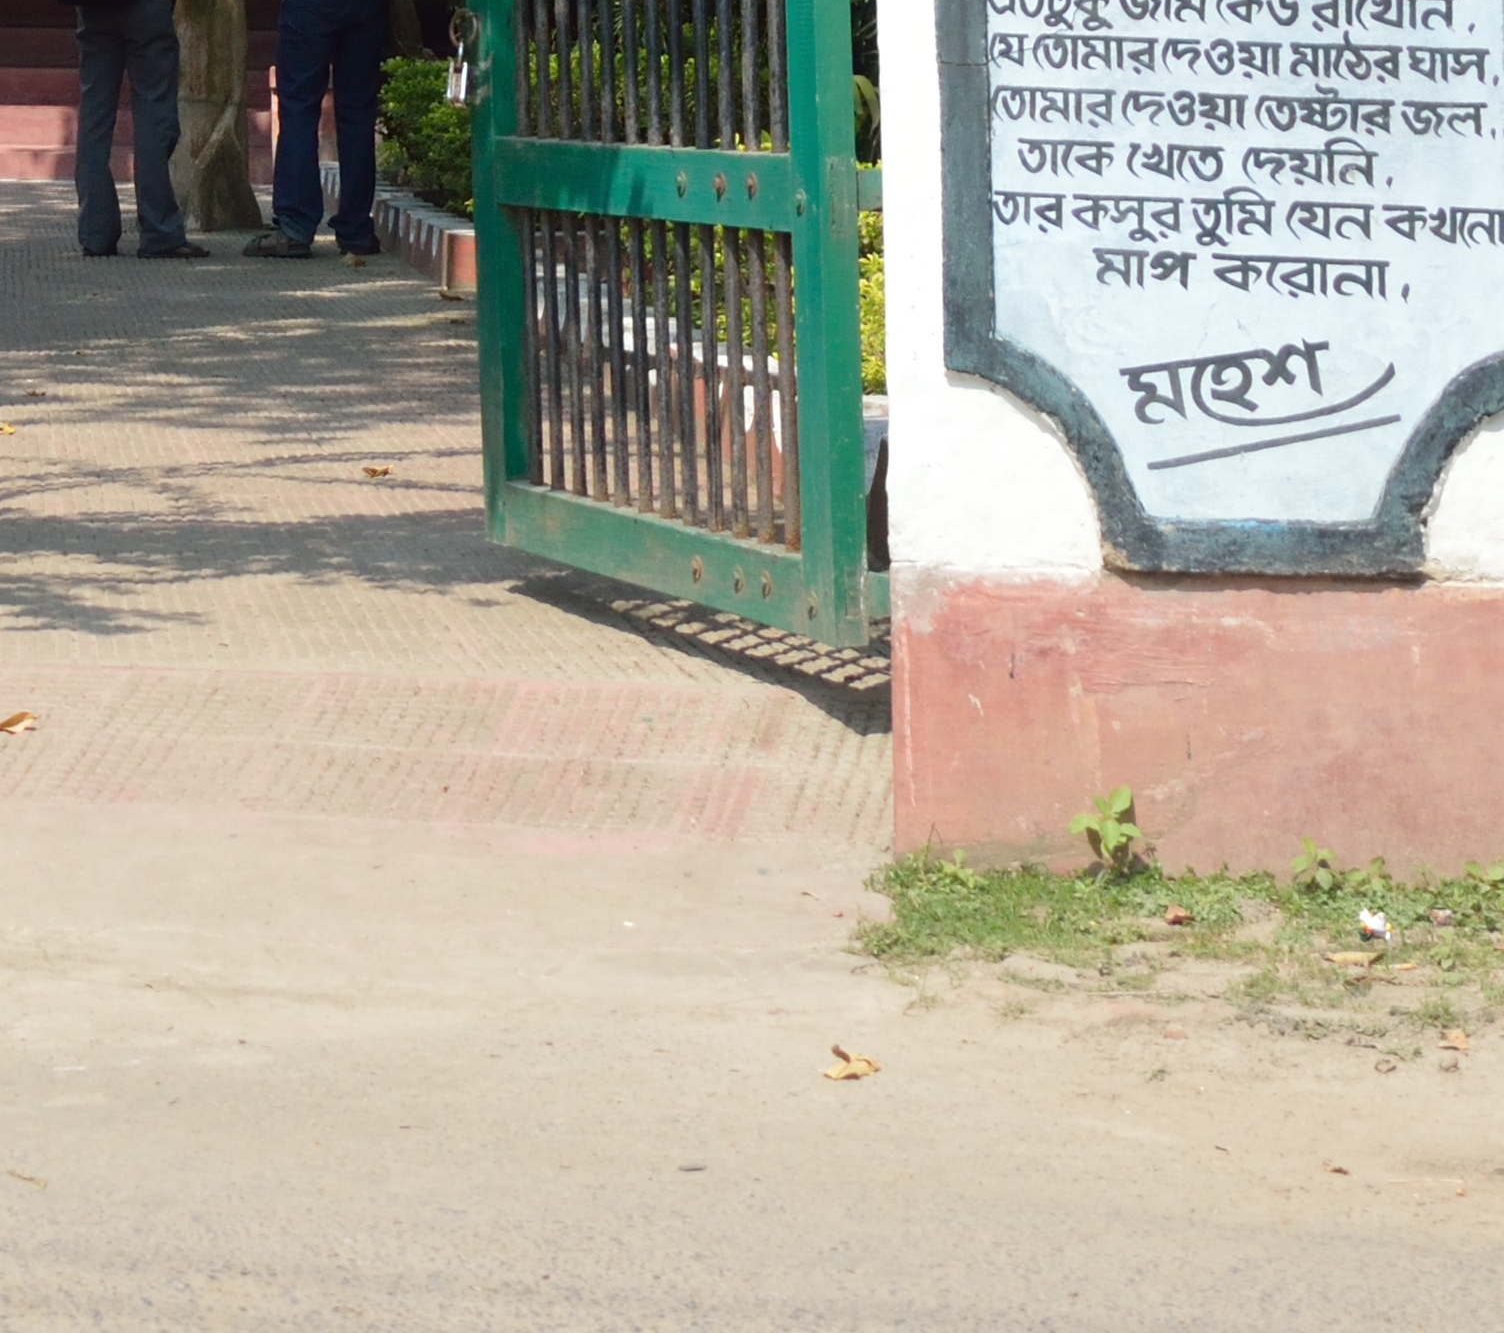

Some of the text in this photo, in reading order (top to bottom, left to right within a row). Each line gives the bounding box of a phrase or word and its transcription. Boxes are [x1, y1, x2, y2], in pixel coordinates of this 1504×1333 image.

[988, 33, 1028, 69] যে
[1032, 34, 1159, 75] তোমার
[1289, 29, 1404, 84] মাঠের
[991, 84, 1117, 129] তোমার
[1254, 82, 1396, 137] তেষ্টার
[1017, 137, 1116, 178] তাকে
[1126, 142, 1226, 183] খেতে
[987, 185, 1068, 234] তার
[1070, 193, 1185, 244] কসুর
[1189, 185, 1277, 248] তুমি
[1285, 200, 1375, 241] যেন
[1091, 247, 1198, 291] মাপ
[1120, 337, 1396, 426] মহেশ
